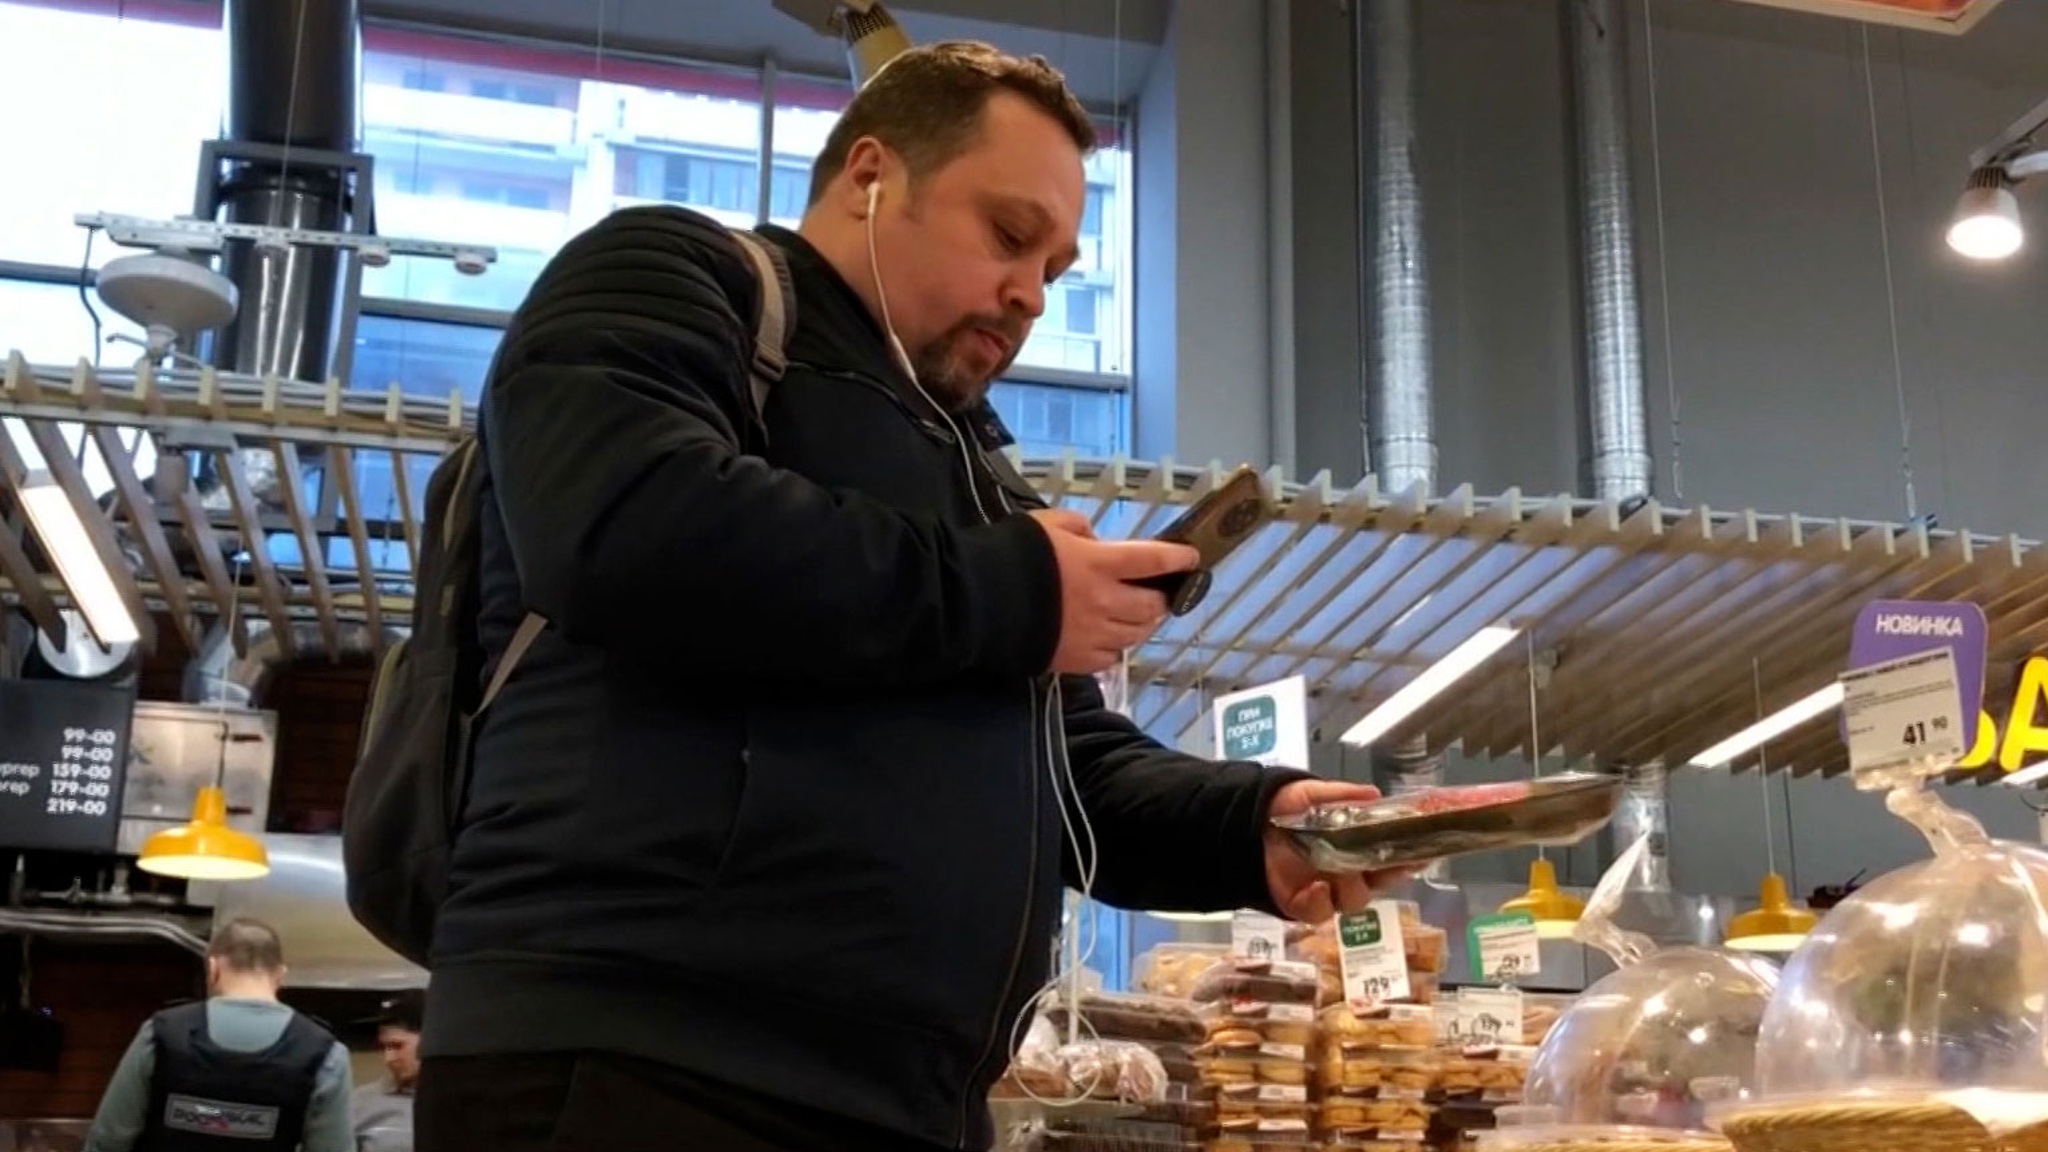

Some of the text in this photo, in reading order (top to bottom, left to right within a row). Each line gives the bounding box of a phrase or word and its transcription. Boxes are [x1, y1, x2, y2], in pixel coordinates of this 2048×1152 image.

[1875, 613, 1964, 637] НОВИНКА
[64, 727, 116, 744] 99-00
[1903, 720, 1926, 745] 41
[61, 745, 114, 762] 99-00
[52, 761, 112, 780] 159-00
[50, 779, 110, 798] 179-00
[46, 797, 107, 816] 219-00
